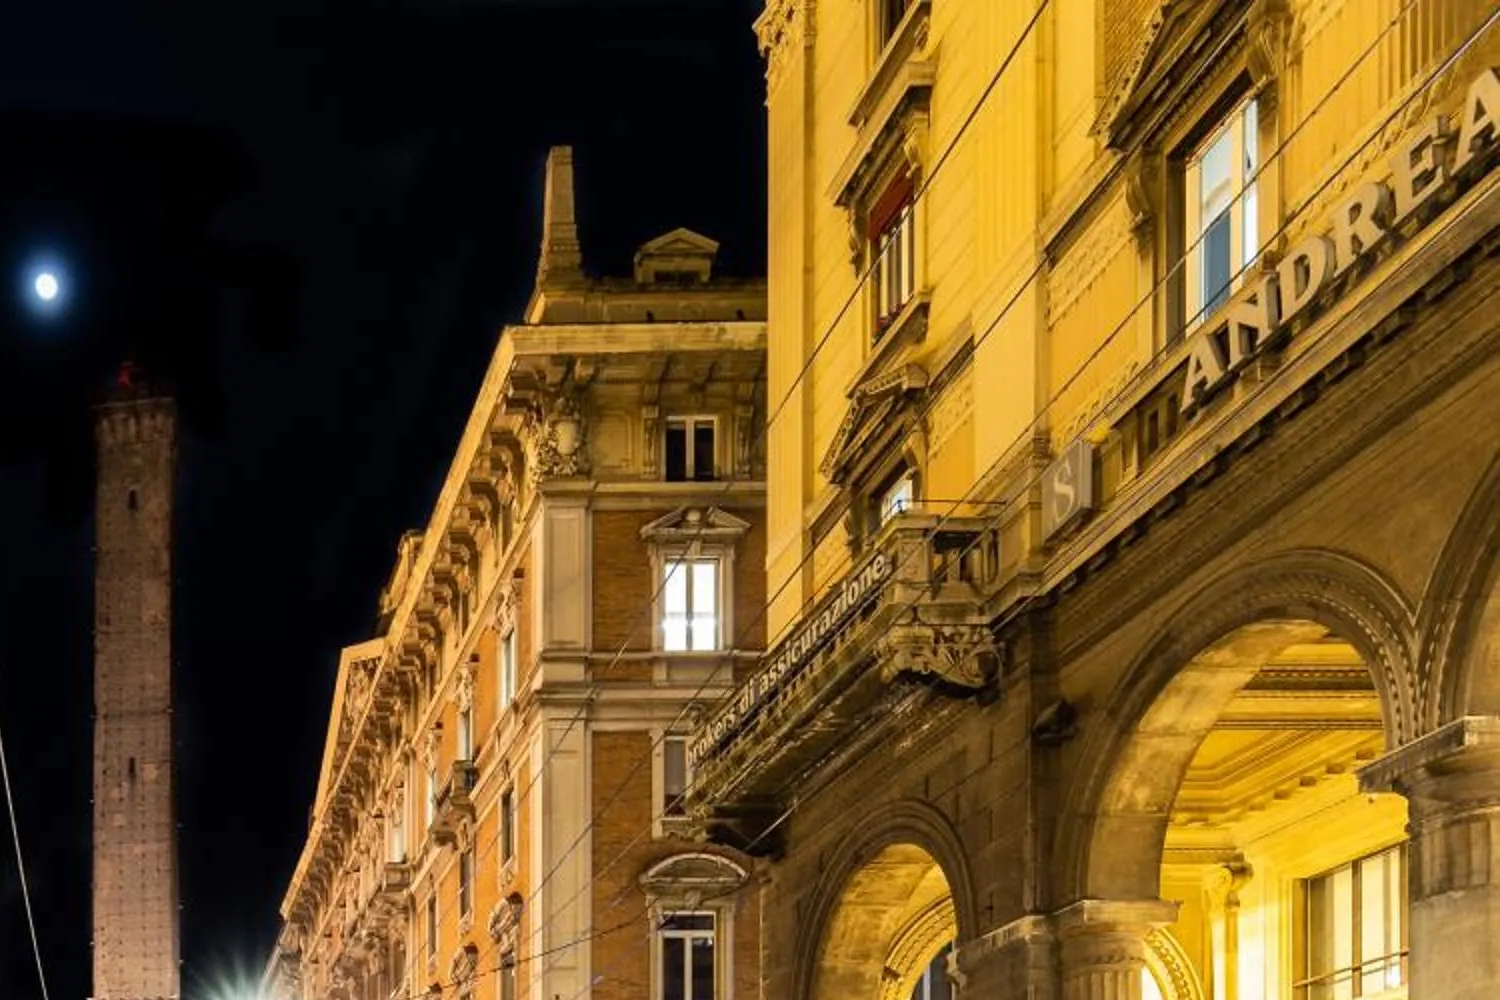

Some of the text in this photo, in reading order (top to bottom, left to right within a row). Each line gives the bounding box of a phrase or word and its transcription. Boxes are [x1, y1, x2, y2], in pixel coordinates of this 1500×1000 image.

[1181, 69, 1500, 414] ANDREA
[686, 553, 887, 768] brokers di assicurazione
